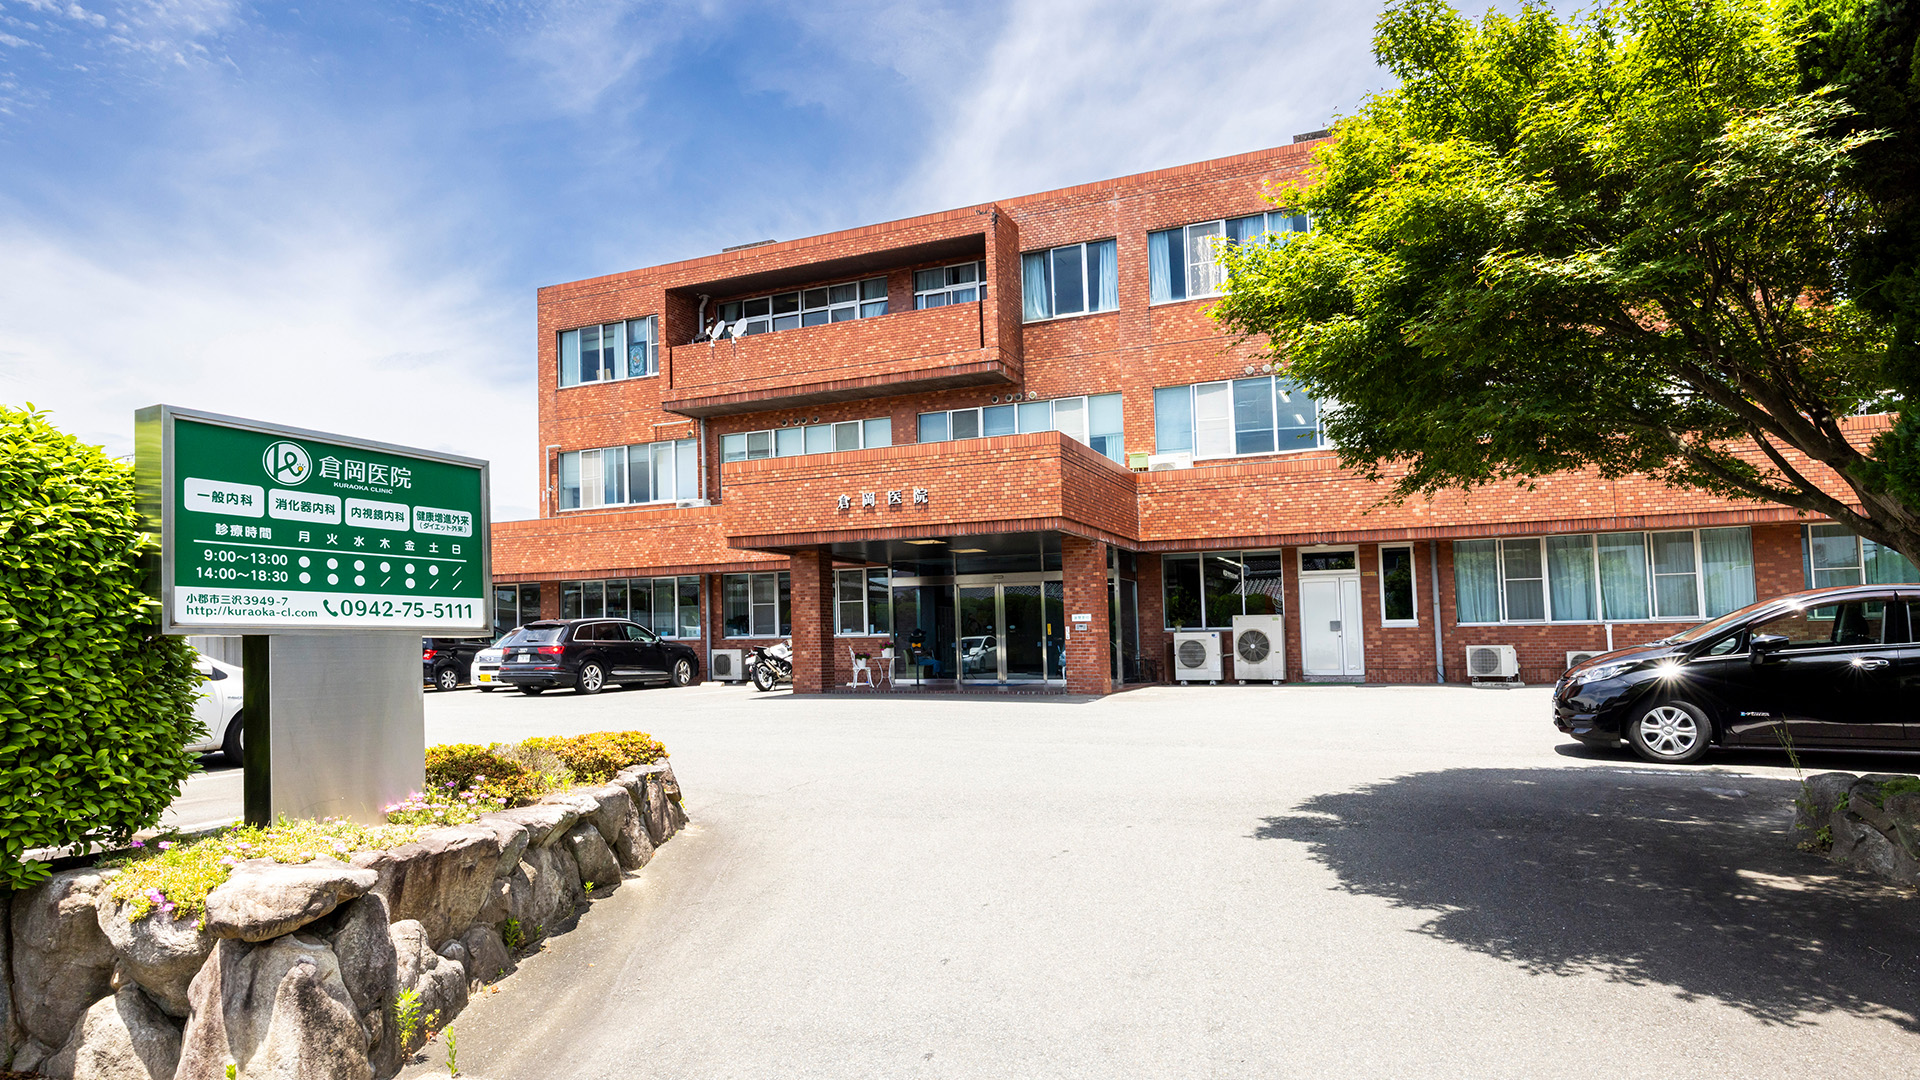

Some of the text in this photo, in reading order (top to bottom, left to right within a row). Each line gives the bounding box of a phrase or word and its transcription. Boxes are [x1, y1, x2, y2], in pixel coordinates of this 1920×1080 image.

[318, 455, 412, 488] 倉岡医院
[333, 481, 393, 495] KURAOKA CLINIC
[197, 490, 253, 507] 一般内科
[275, 497, 336, 516] 消化器内科
[836, 487, 929, 510] 倉岡医院
[350, 506, 405, 523] 内視鏡内科
[416, 510, 470, 526] 健康増進外来
[215, 522, 461, 555] 診療時間 月 火 水 木 金 土 日
[186, 593, 288, 606] 小郡市三沢3949-7
[186, 605, 318, 618] http://kuraoka-cl.com
[340, 599, 473, 619] 0942-75-5111
